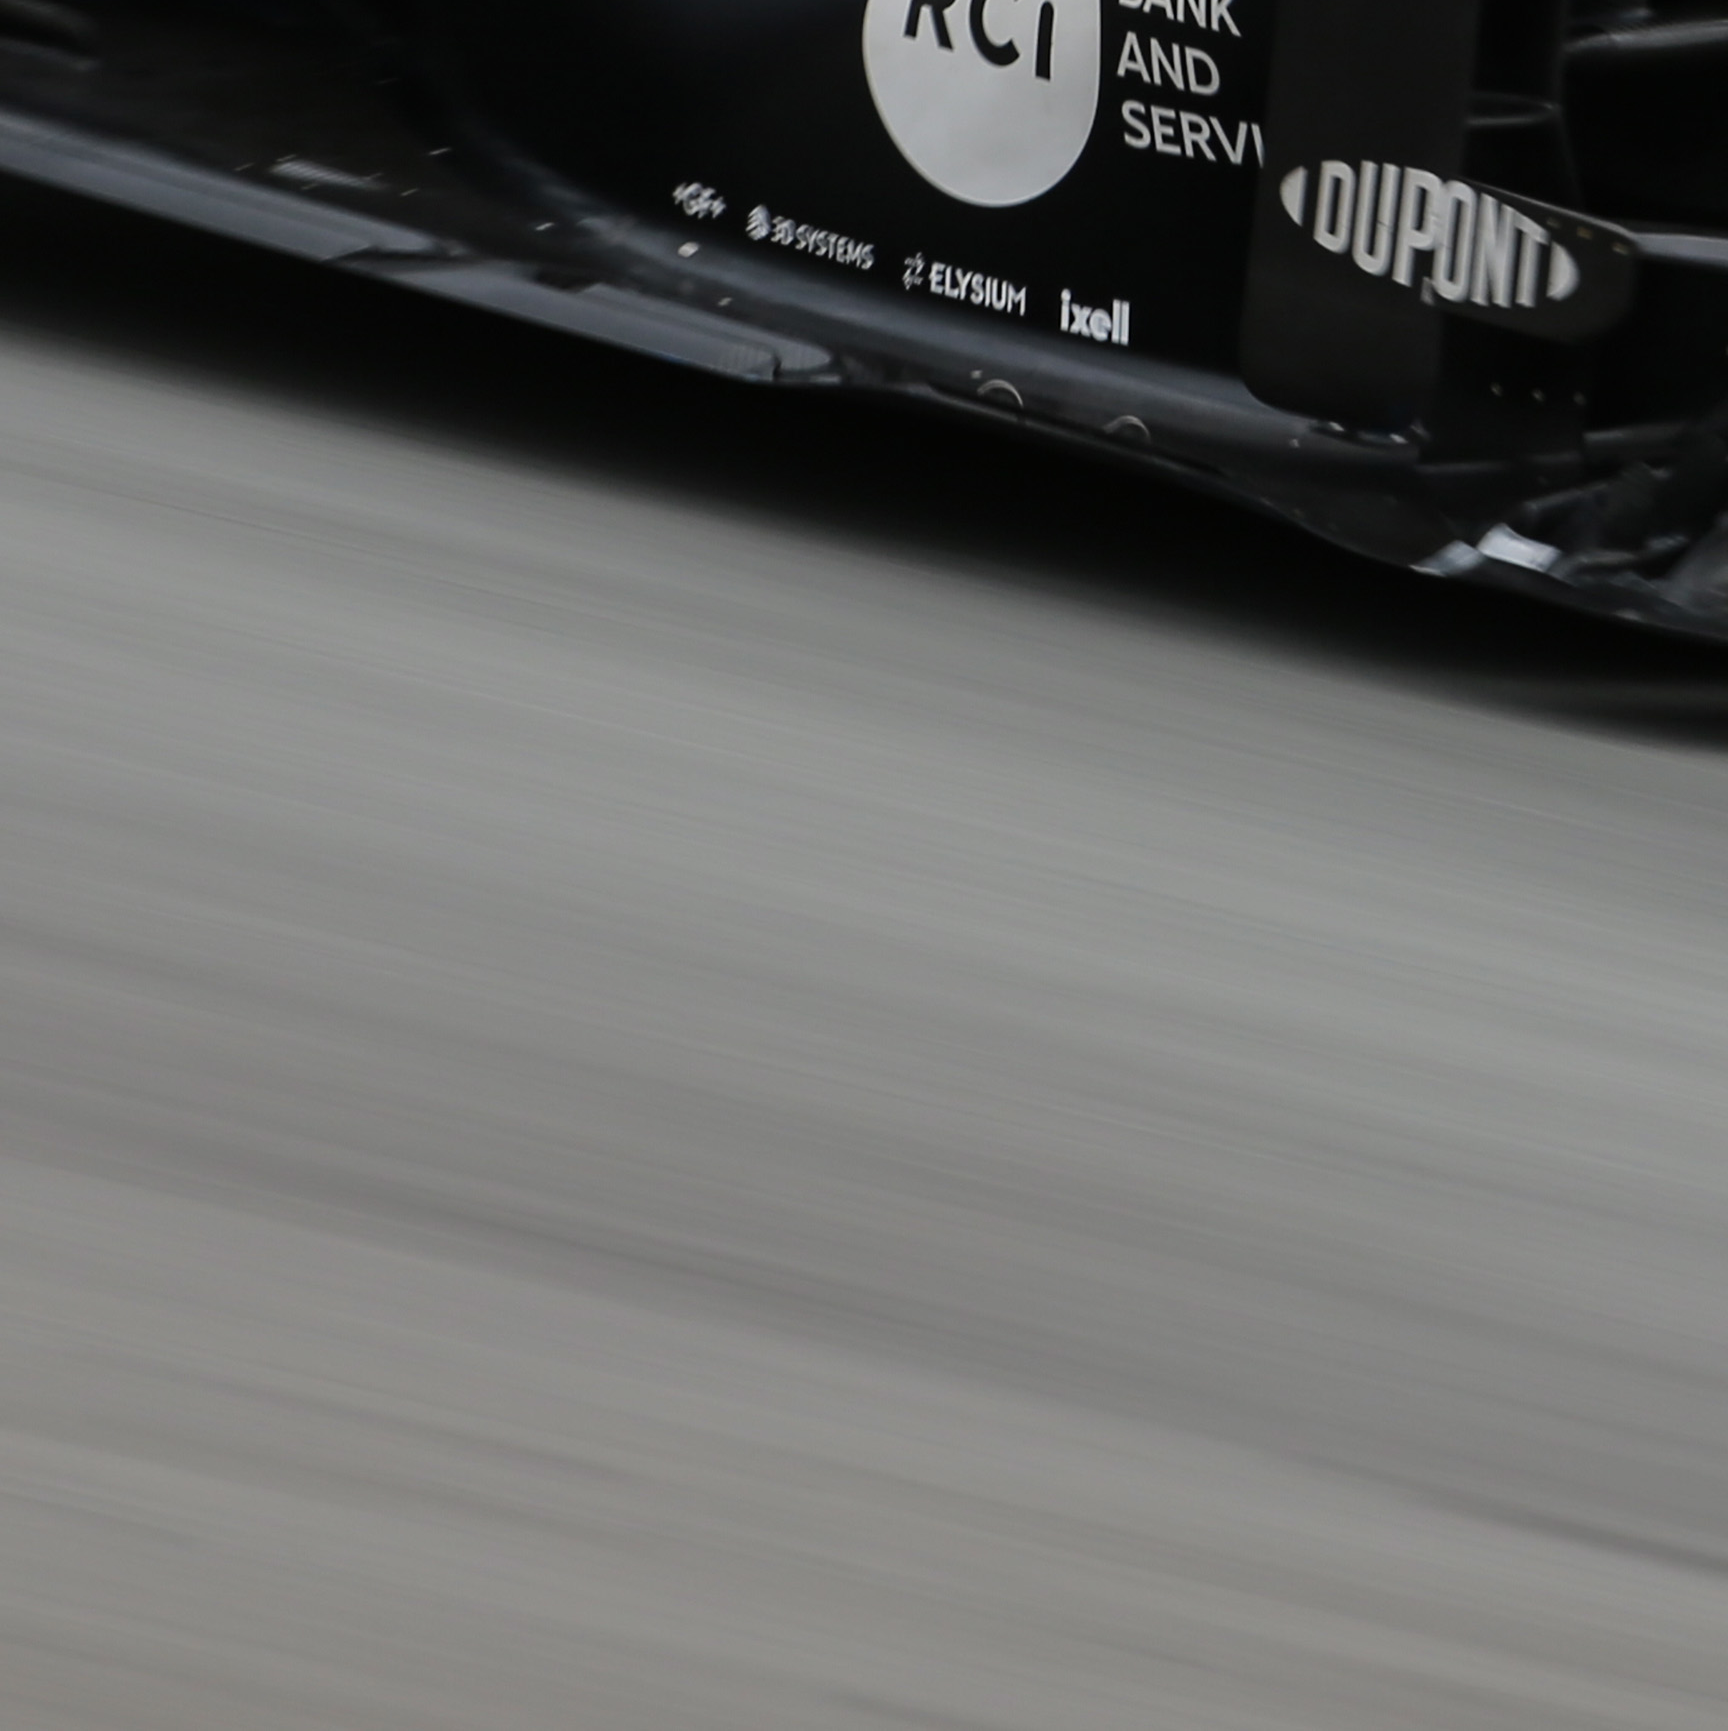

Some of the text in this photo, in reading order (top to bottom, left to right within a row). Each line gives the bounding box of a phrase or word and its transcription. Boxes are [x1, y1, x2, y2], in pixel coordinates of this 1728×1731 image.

[1116, 30, 1221, 97] AND
[795, 224, 875, 270] SYSTEMS
[1313, 159, 1549, 309] DUPONT
[928, 261, 1027, 317] ELYSIUM
[1060, 287, 1131, 347] ixell
